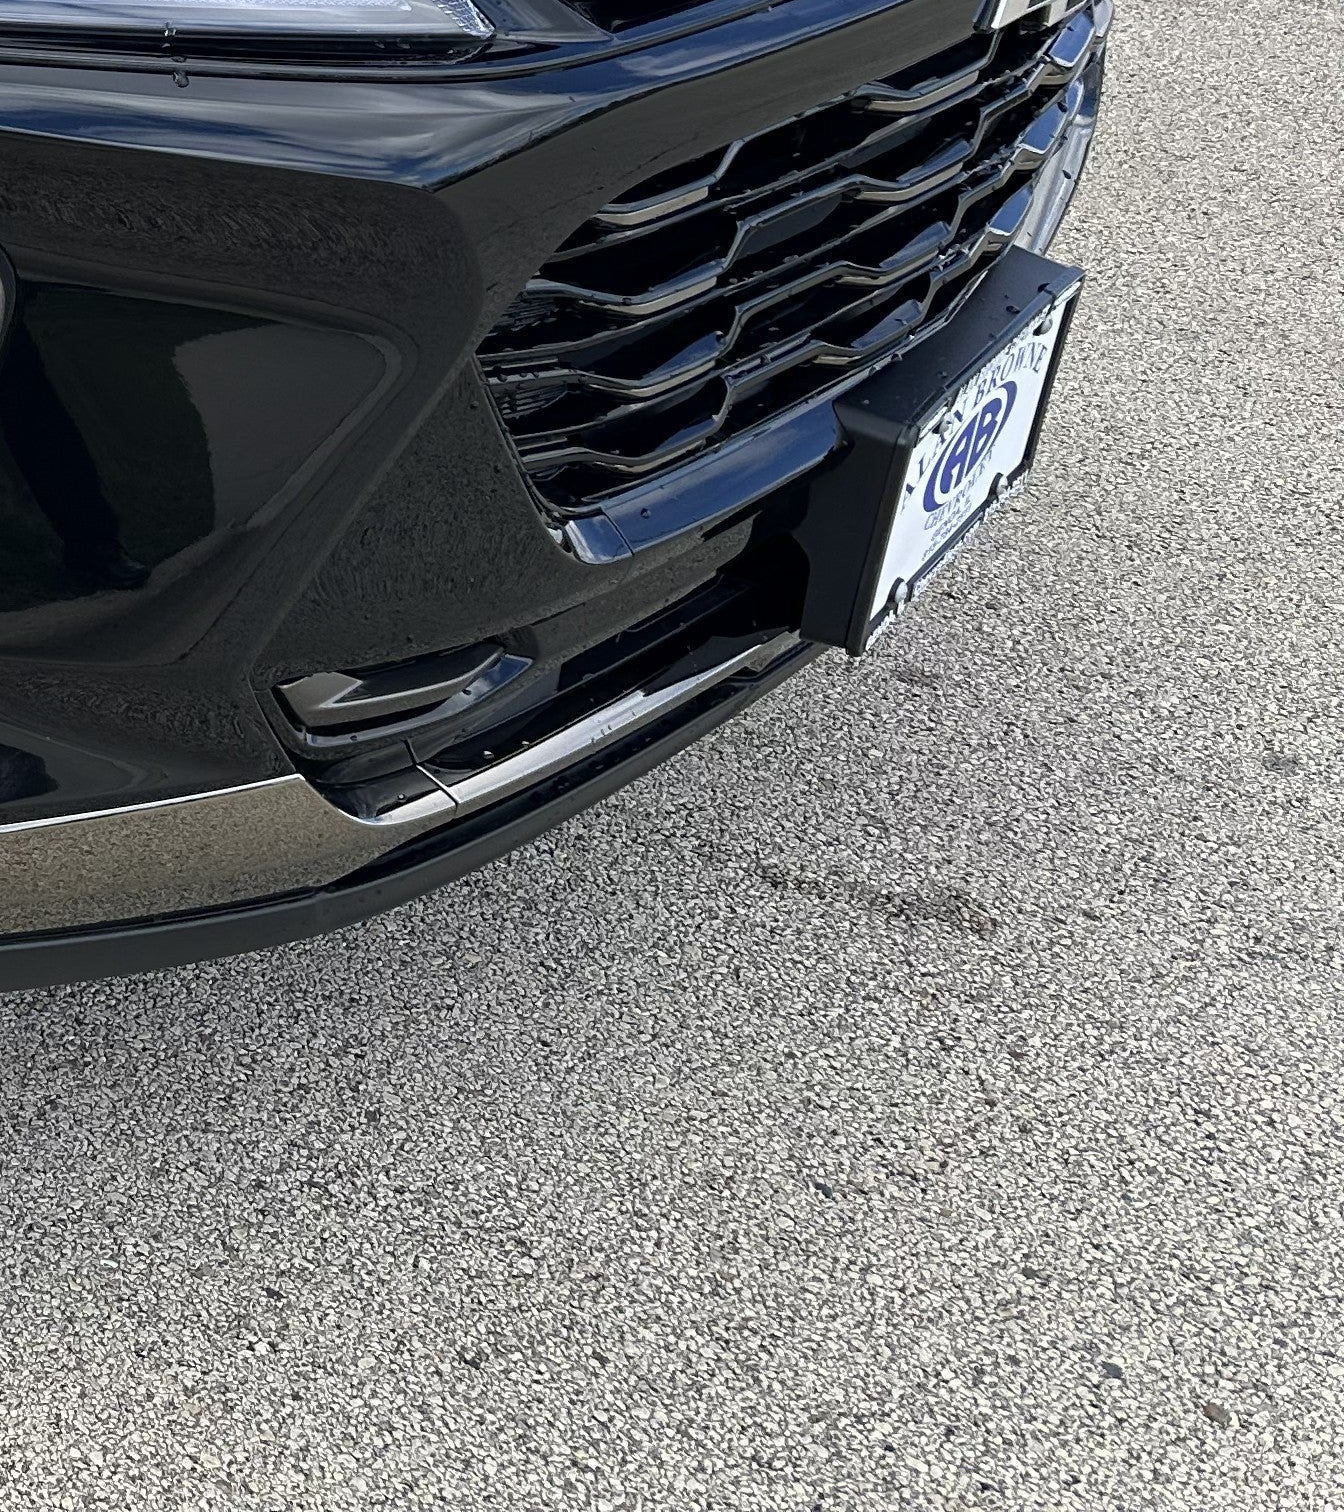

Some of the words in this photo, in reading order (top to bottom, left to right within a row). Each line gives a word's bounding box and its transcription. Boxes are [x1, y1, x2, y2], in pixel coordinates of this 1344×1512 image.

[900, 396, 969, 516] ALAN
[973, 341, 1048, 410] BROWNE
[940, 397, 1003, 495] AB
